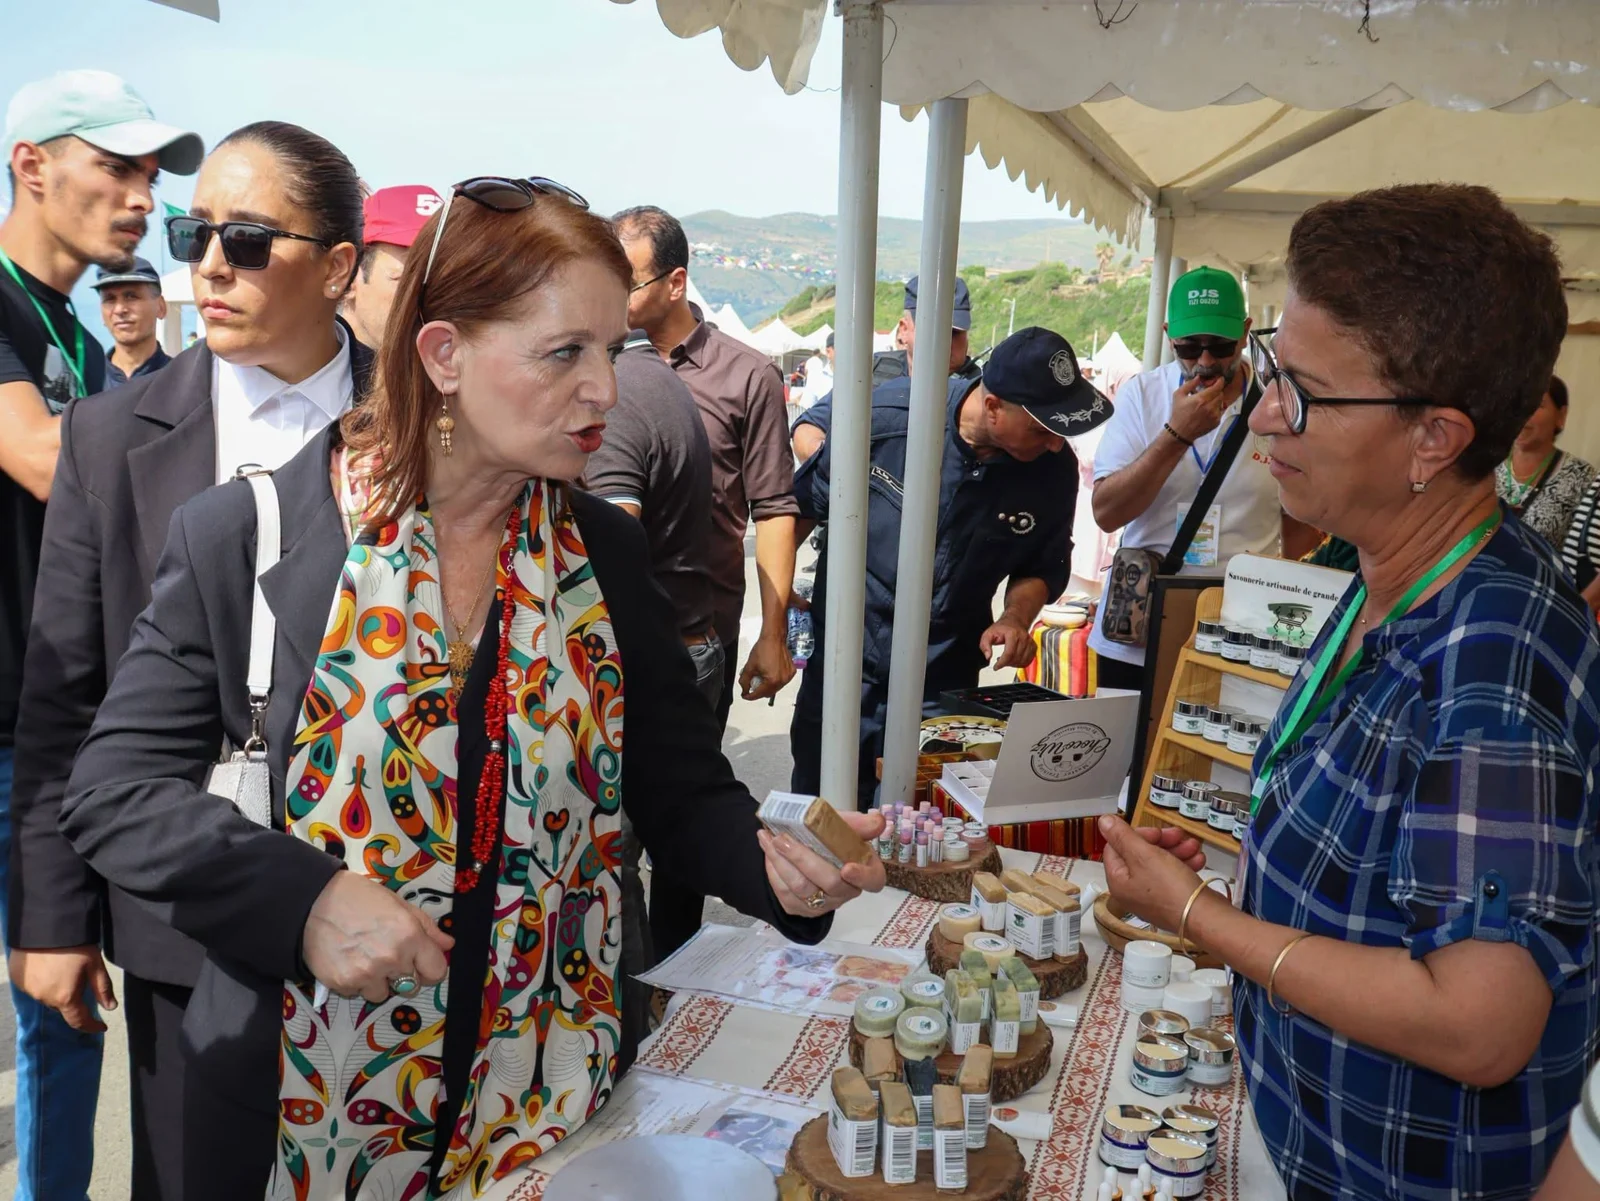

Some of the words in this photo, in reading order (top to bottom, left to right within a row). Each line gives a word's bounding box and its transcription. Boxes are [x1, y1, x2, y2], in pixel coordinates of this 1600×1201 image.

[416, 194, 444, 216] 5
[1188, 289, 1219, 299] DJS
[1228, 572, 1265, 586] Savonnerie
[1266, 580, 1301, 594] artisanale
[1303, 587, 1312, 596] de
[1313, 590, 1339, 602] grande
[1030, 736, 1111, 758] ChocoWiz
